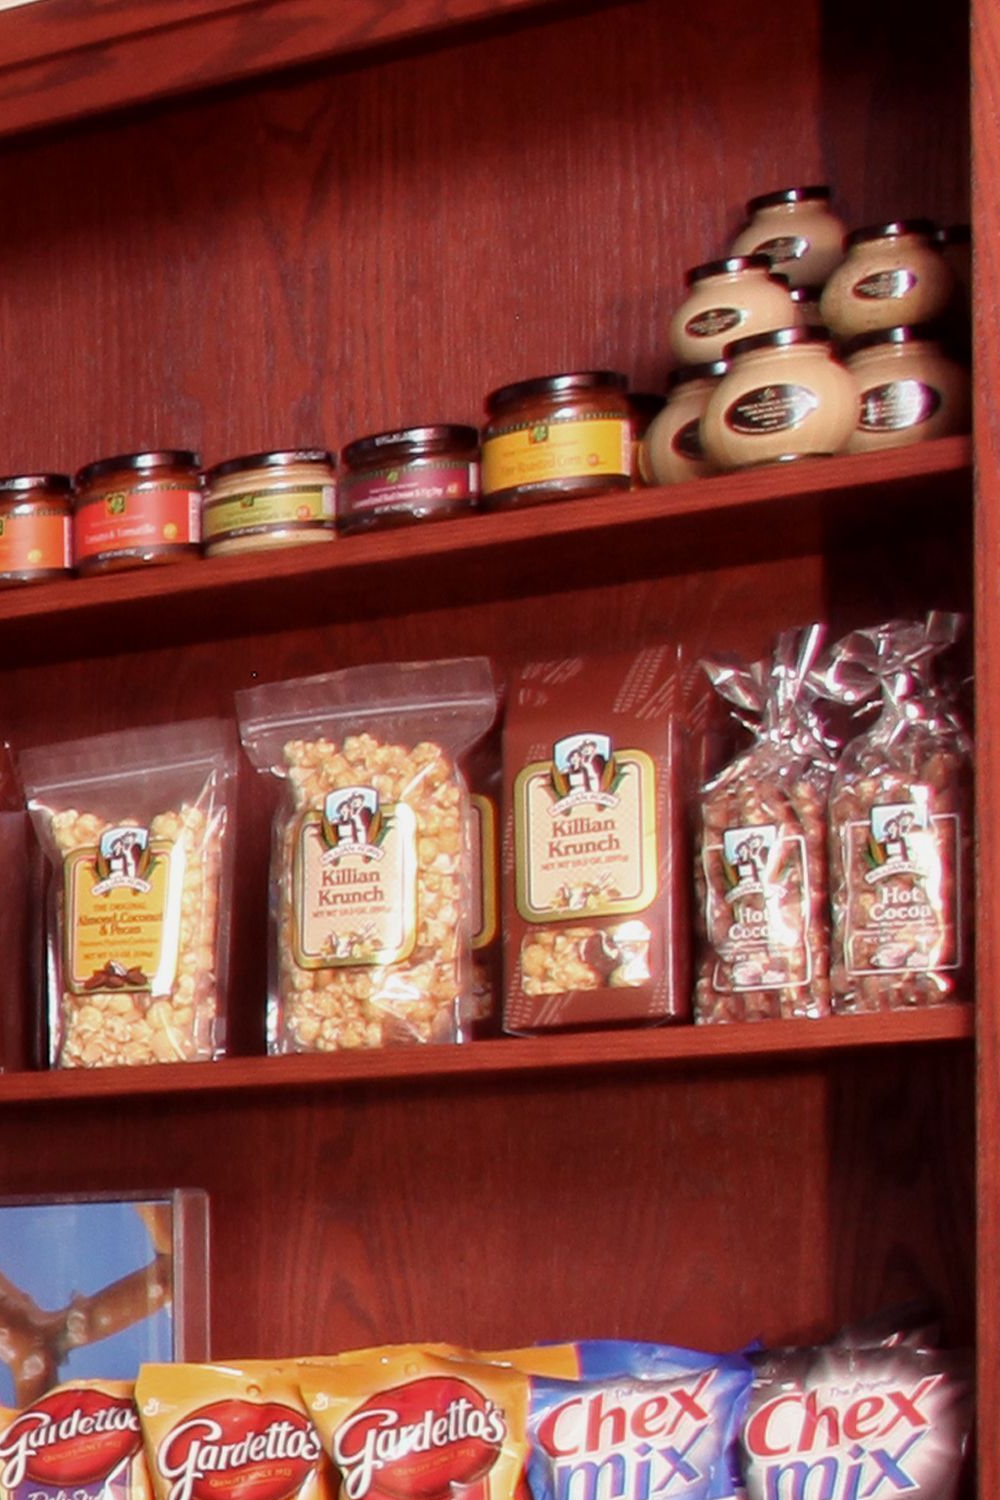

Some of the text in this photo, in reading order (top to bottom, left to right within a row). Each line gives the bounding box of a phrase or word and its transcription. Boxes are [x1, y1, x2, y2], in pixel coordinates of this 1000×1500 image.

[552, 817, 616, 838] Killian
[548, 833, 620, 858] Krunch
[322, 867, 381, 887] Killian
[318, 886, 385, 907] Krunch
[881, 886, 925, 903] Hot
[869, 903, 932, 921] Cocoa
[537, 1369, 718, 1459] Chex
[746, 1372, 943, 1460] Chex
[334, 1398, 505, 1500] Gardetto's
